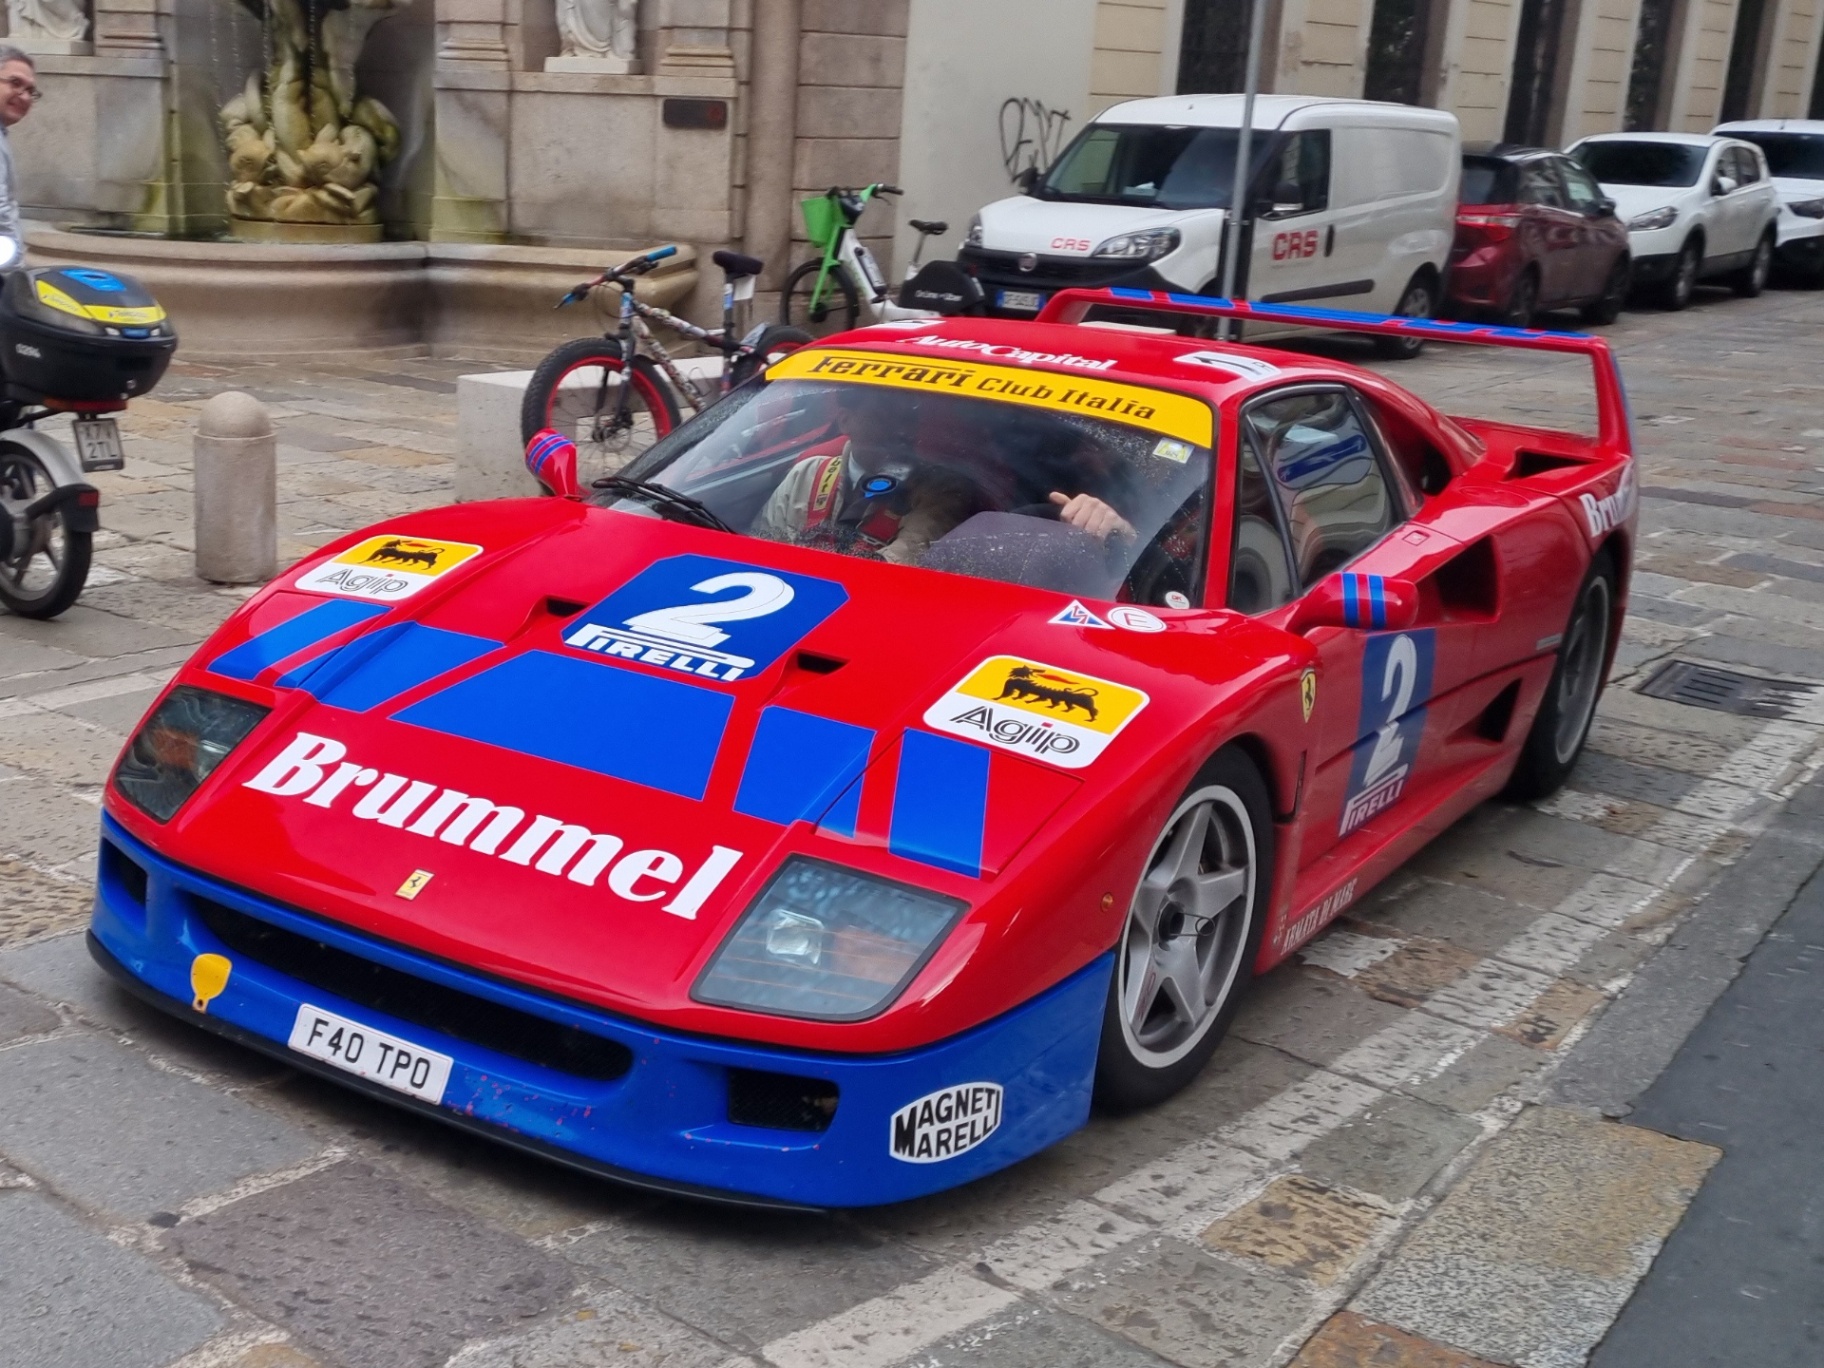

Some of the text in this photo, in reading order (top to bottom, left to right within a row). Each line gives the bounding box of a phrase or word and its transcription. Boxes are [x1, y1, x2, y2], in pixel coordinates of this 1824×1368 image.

[1050, 237, 1091, 251] CRS
[1273, 230, 1319, 260] CRS
[896, 335, 1119, 370] AutoCapital
[807, 356, 1157, 420] Ferrari Club Italia
[315, 568, 409, 595] Agip
[622, 572, 795, 648] 2
[1123, 611, 1152, 630] E
[564, 623, 755, 682] PIRELLI
[950, 705, 1081, 754] Agip
[1363, 633, 1418, 787] 2
[1338, 763, 1409, 838] PIRELLI
[242, 732, 743, 920] Brummel
[307, 1017, 364, 1064] F40
